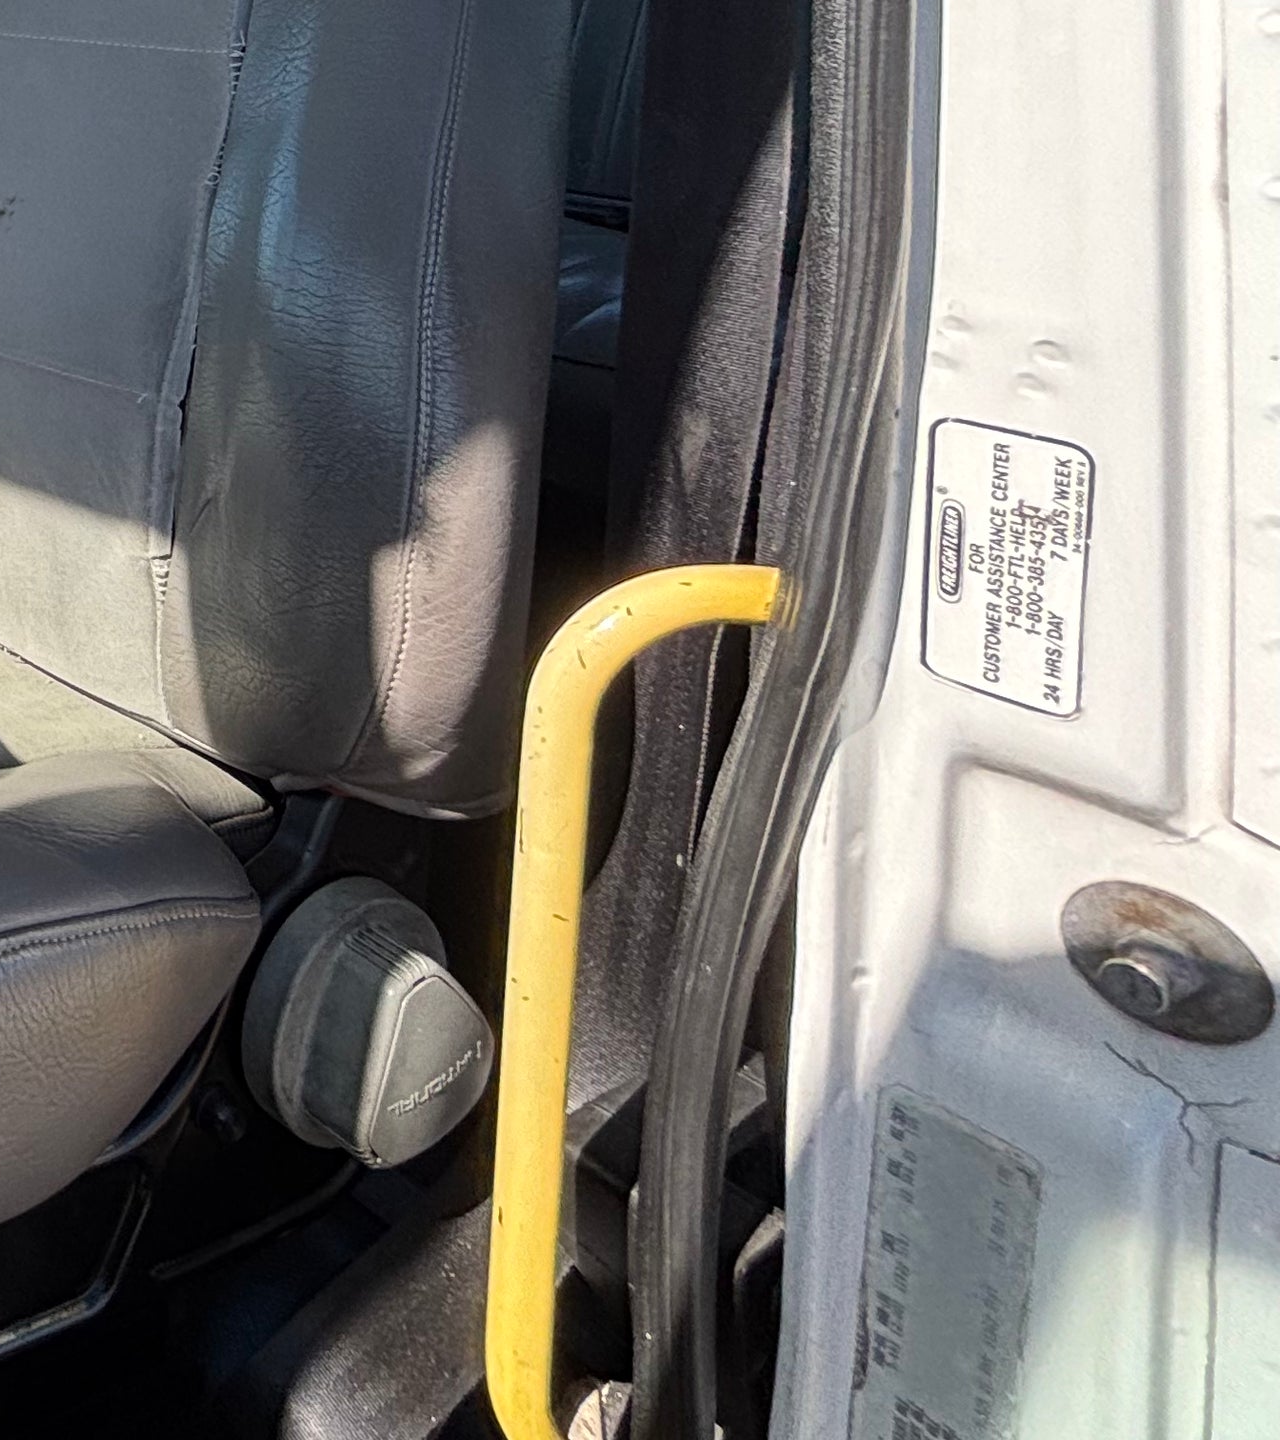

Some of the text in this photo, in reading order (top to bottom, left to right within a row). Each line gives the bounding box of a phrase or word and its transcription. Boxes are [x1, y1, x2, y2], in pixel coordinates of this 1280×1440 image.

[940, 506, 962, 595] FREIGHTLINER
[1051, 456, 1072, 561] 7 DAYS/WEEK
[969, 544, 984, 574] FOR
[983, 443, 1010, 684] CUSTOMER ASSISTANCE CENTER
[1006, 507, 1026, 629] 1-800-FTL-HELP
[1044, 610, 1064, 704] 24 HRS/DAY
